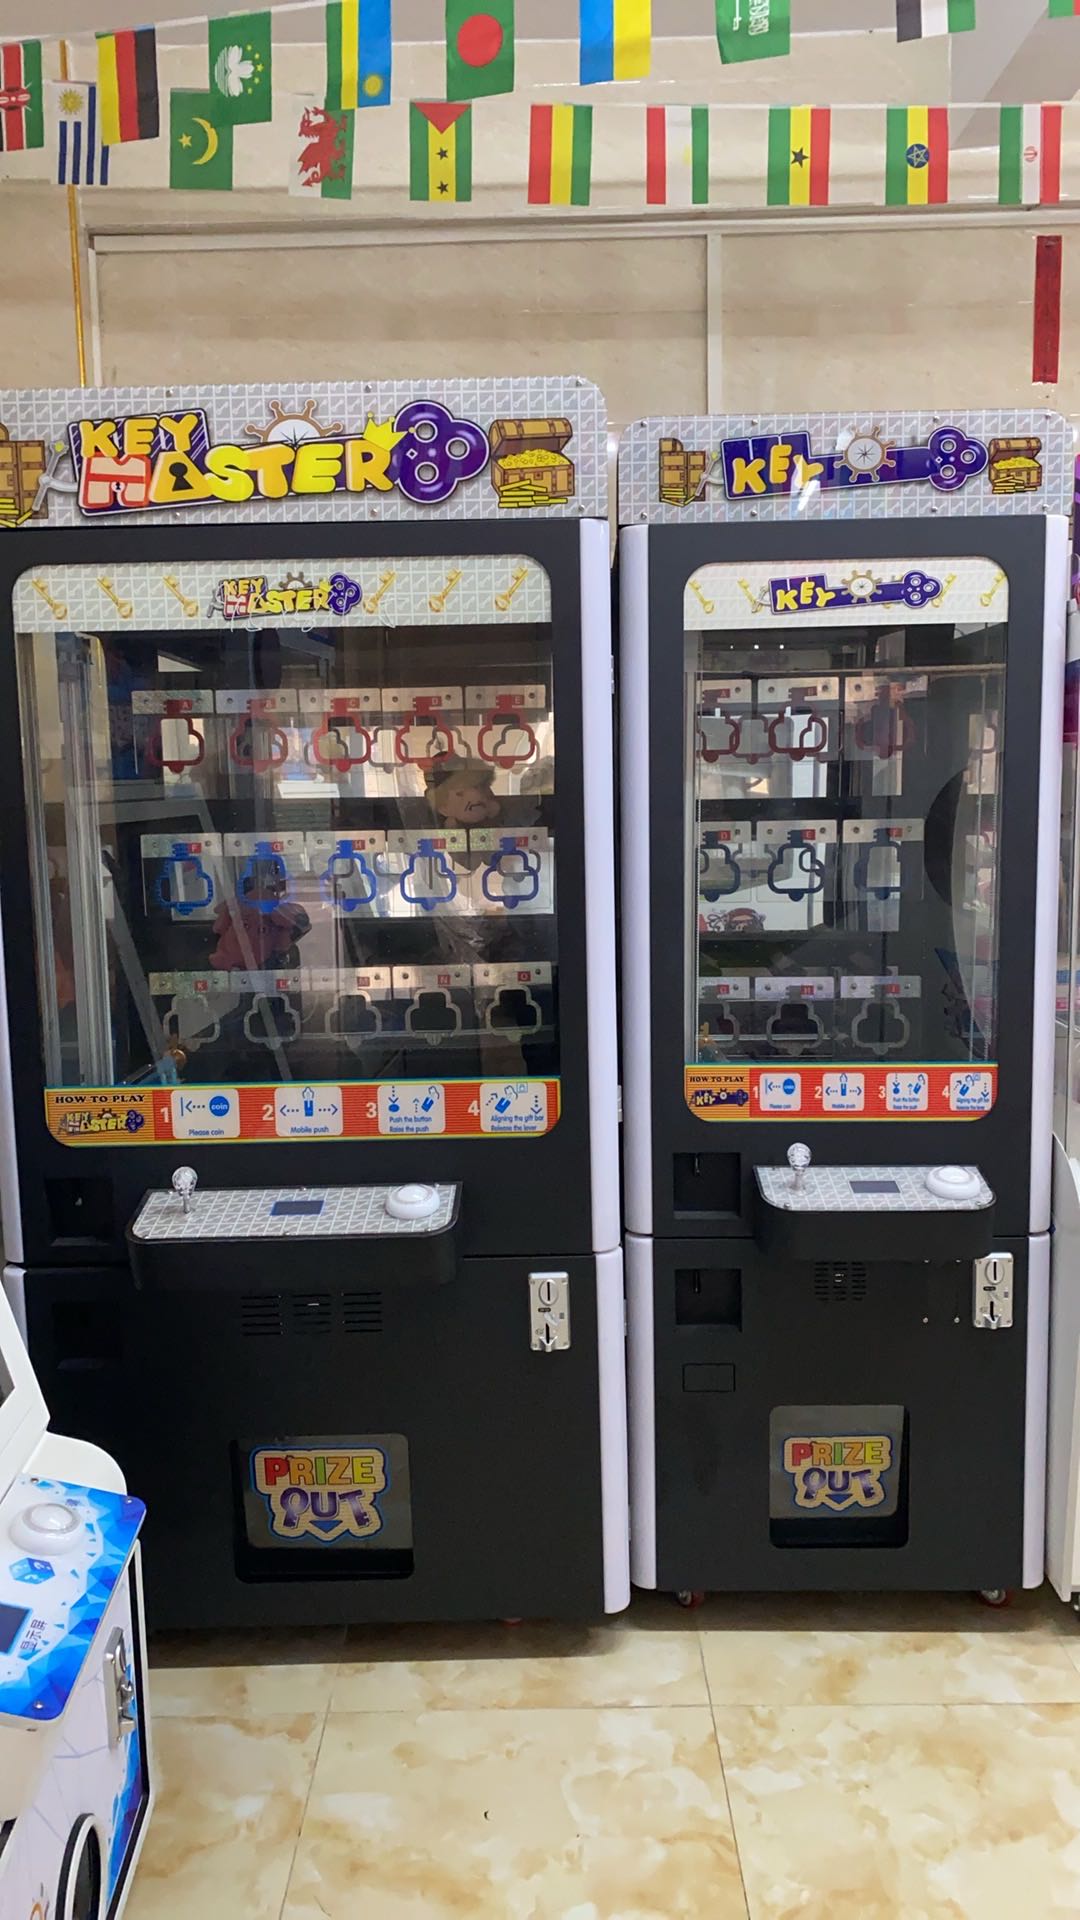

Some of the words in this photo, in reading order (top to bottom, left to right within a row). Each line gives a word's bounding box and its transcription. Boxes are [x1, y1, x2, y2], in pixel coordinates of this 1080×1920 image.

[79, 412, 198, 458] KEY
[78, 439, 397, 509] MASTER
[732, 444, 825, 494] KEY
[223, 577, 264, 595] KEY
[776, 581, 836, 610] KEY
[55, 1096, 86, 1104] HOW
[90, 1095, 108, 1103] TO
[113, 1095, 145, 1103] PLAY
[752, 1085, 759, 1099] 1
[814, 1085, 822, 1099] 2
[878, 1085, 886, 1099] 3
[942, 1085, 950, 1099] 4
[160, 1106, 170, 1123] 1
[262, 1104, 274, 1120] 2
[366, 1102, 377, 1118] 3
[467, 1100, 480, 1116] 4
[792, 1440, 884, 1467] PRIZE
[264, 1455, 376, 1486] PRIZE
[802, 1467, 876, 1500] OUT
[280, 1487, 372, 1529] OUT
